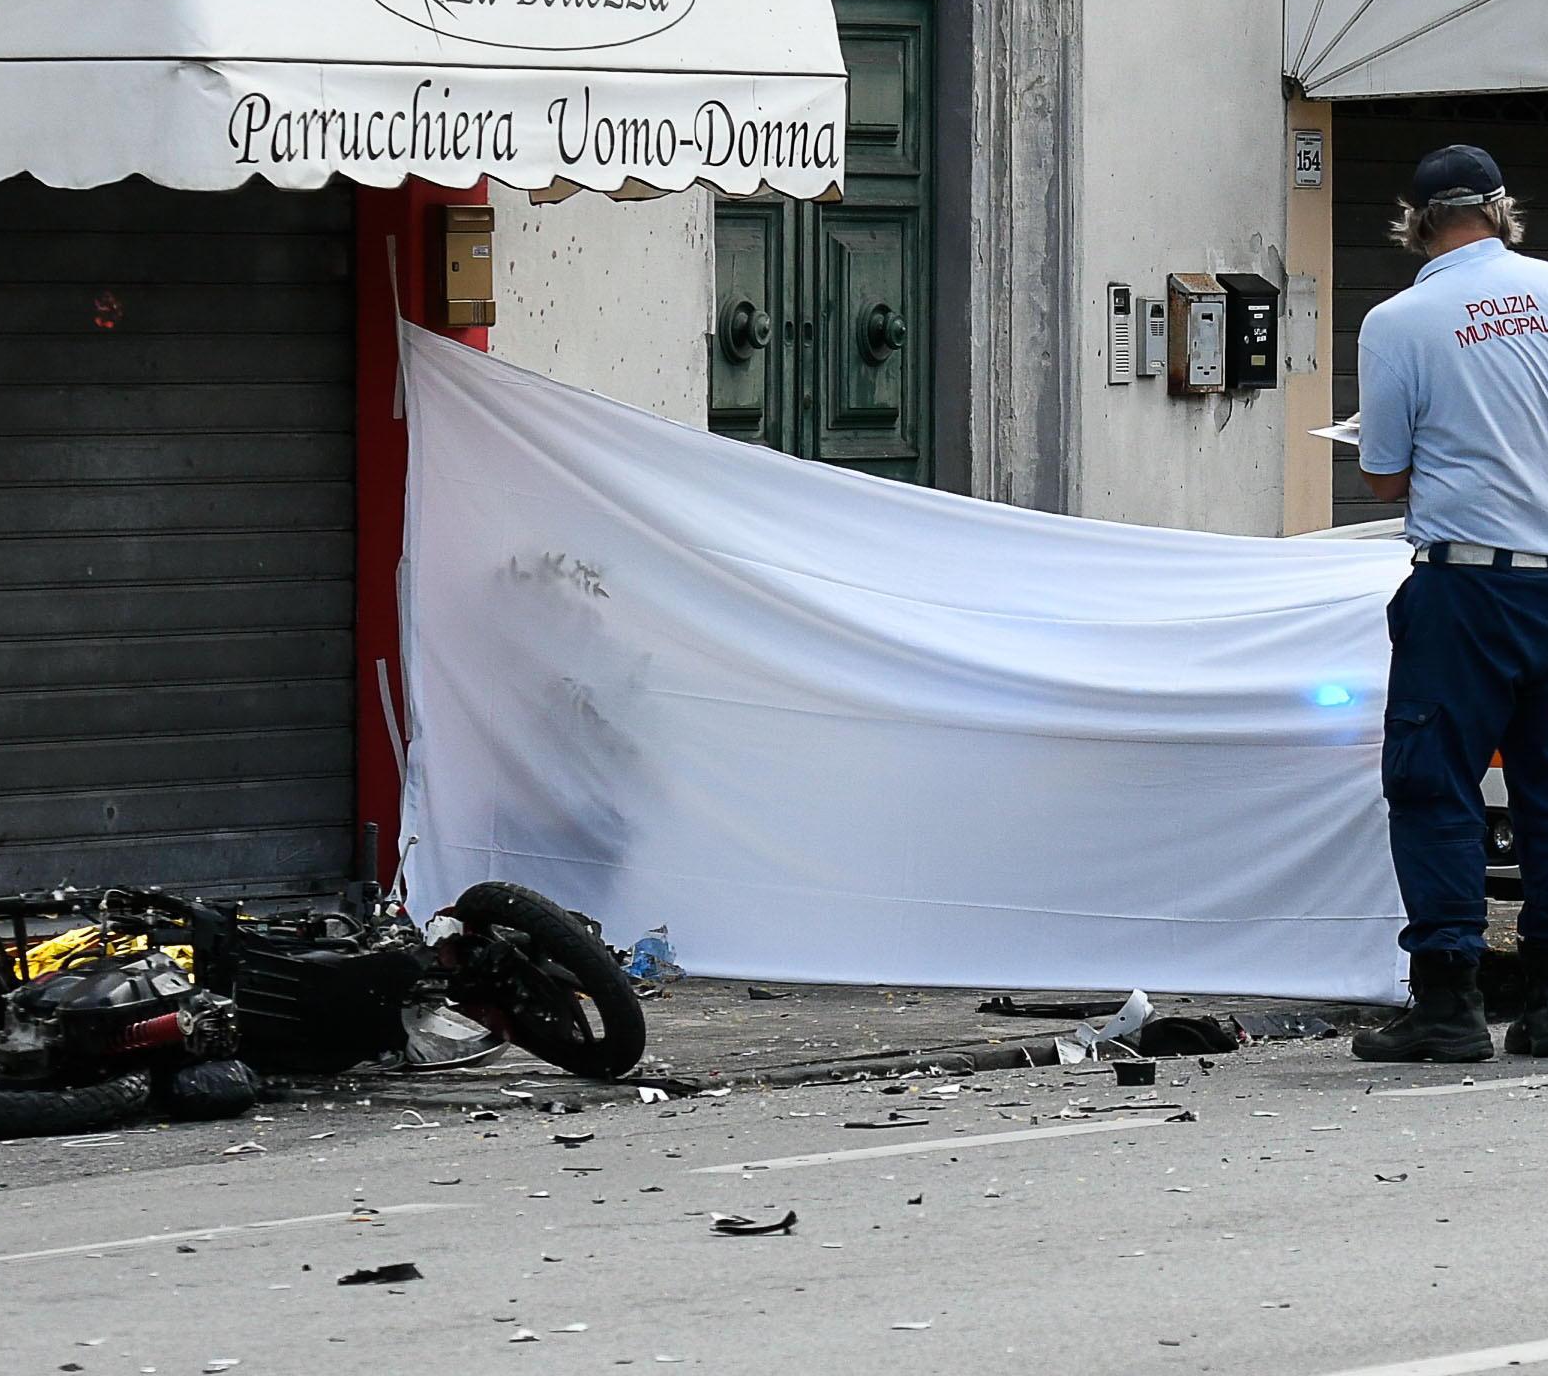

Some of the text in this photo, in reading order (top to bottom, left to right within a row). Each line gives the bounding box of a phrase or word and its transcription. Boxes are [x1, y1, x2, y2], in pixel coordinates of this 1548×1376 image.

[228, 78, 840, 169] Parrucchiera Uomo-Donna
[1296, 149, 1321, 172] 154
[1465, 294, 1540, 321] POLIZIA
